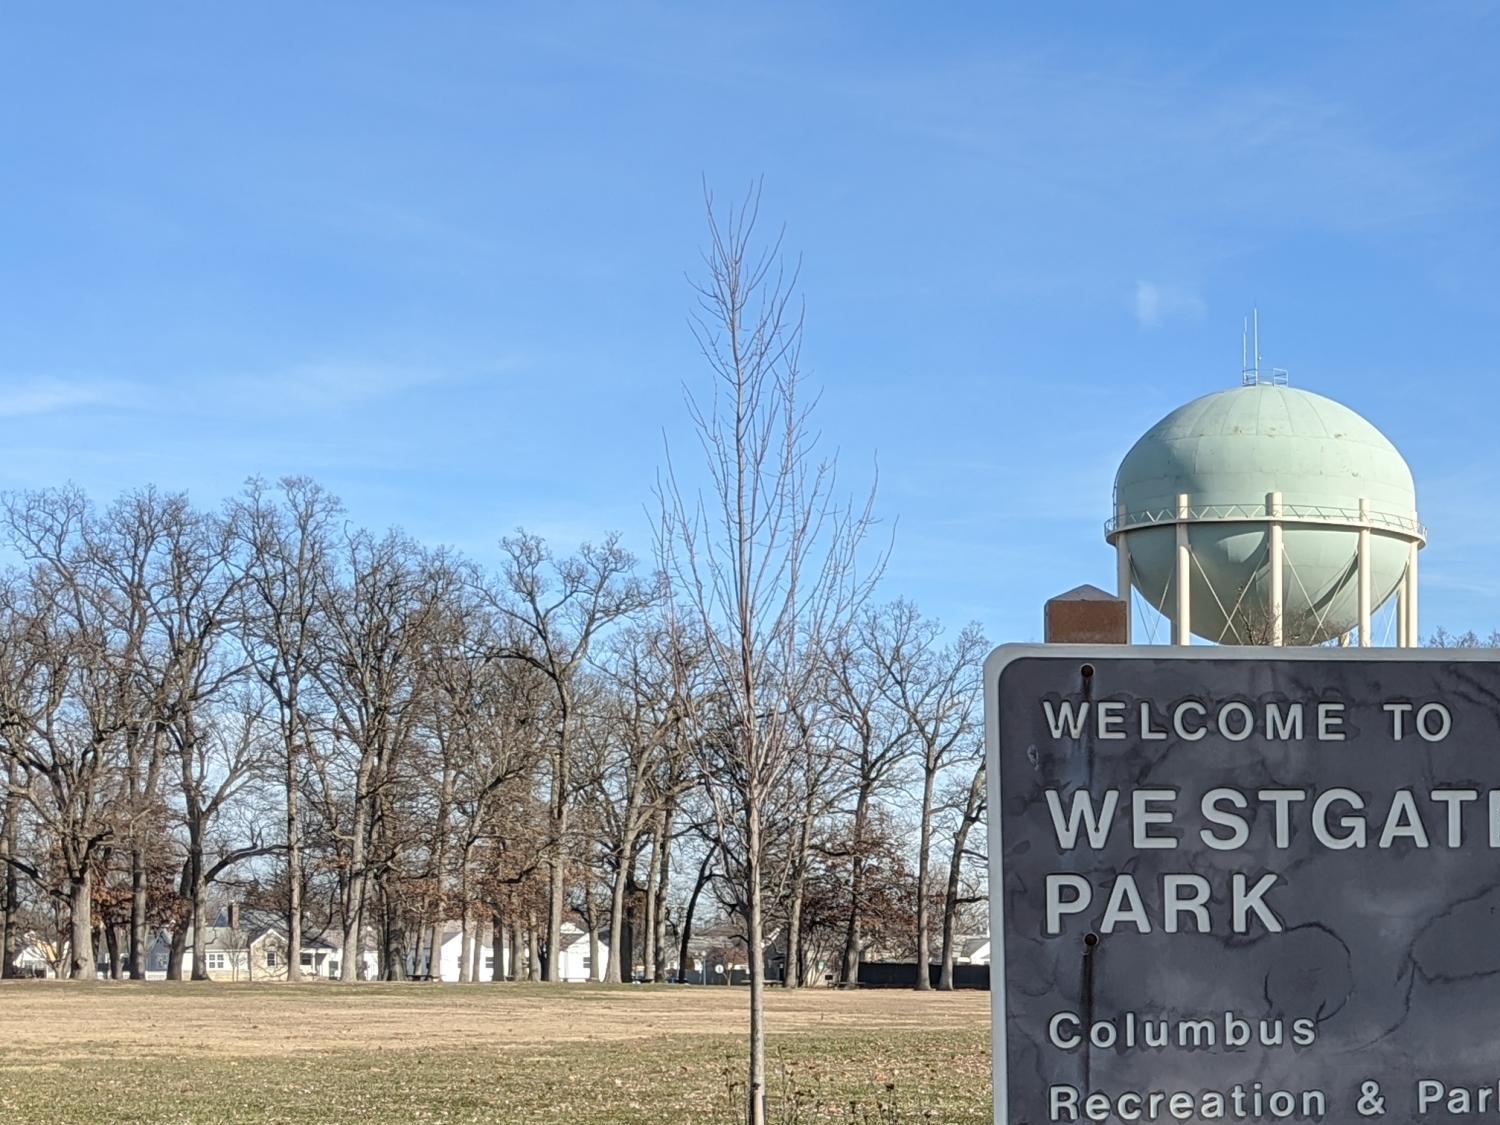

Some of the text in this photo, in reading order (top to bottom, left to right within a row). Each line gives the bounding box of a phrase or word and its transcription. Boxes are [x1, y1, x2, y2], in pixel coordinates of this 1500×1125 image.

[1043, 701, 1451, 743] WELCOME TO
[1046, 874, 1282, 934] PARK
[1049, 1012, 1316, 1049] Columbus
[1050, 1083, 1325, 1121] Recreation
[1356, 1081, 1386, 1116] &
